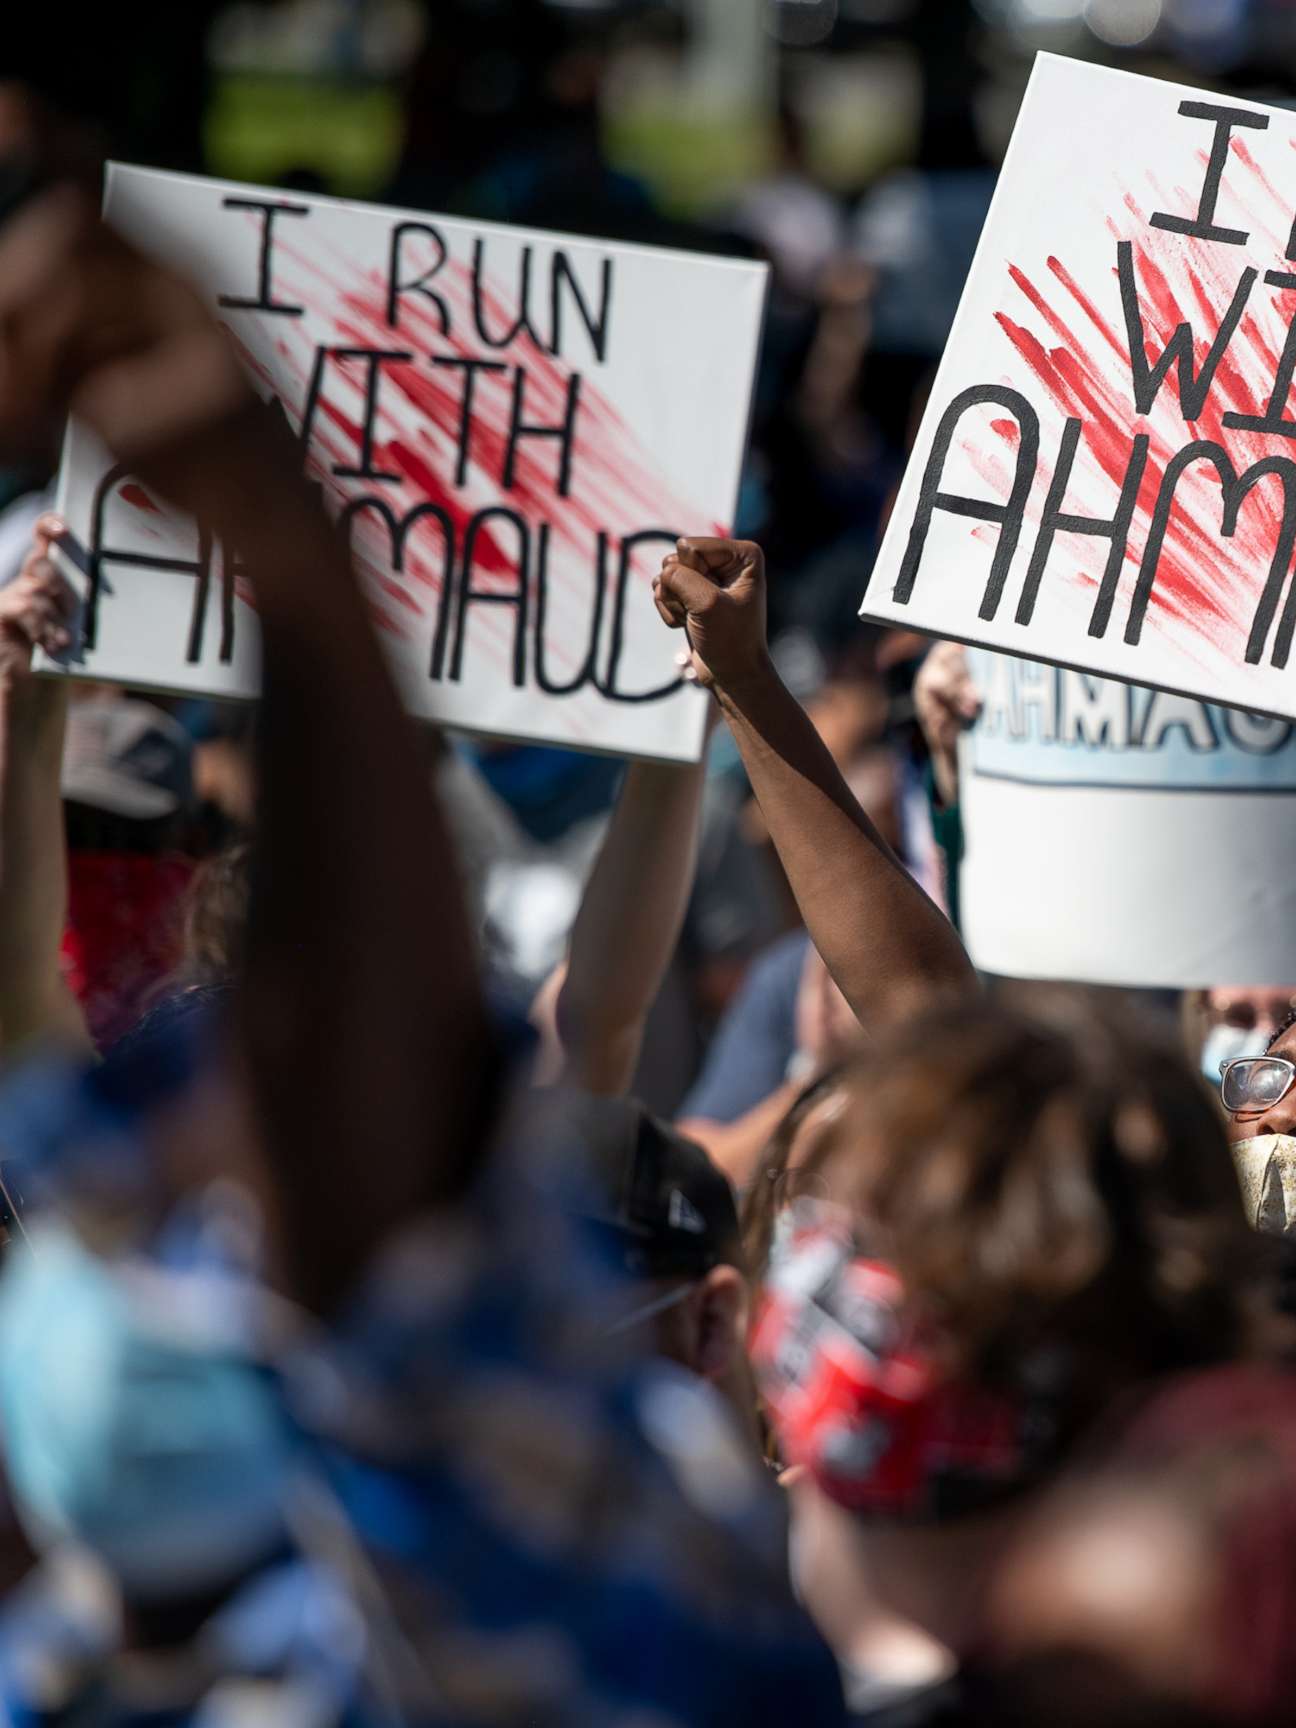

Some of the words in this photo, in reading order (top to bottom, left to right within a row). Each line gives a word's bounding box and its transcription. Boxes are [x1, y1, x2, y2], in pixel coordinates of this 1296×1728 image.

[1149, 100, 1270, 246] I
[217, 197, 310, 318] I
[386, 222, 612, 362] RUN
